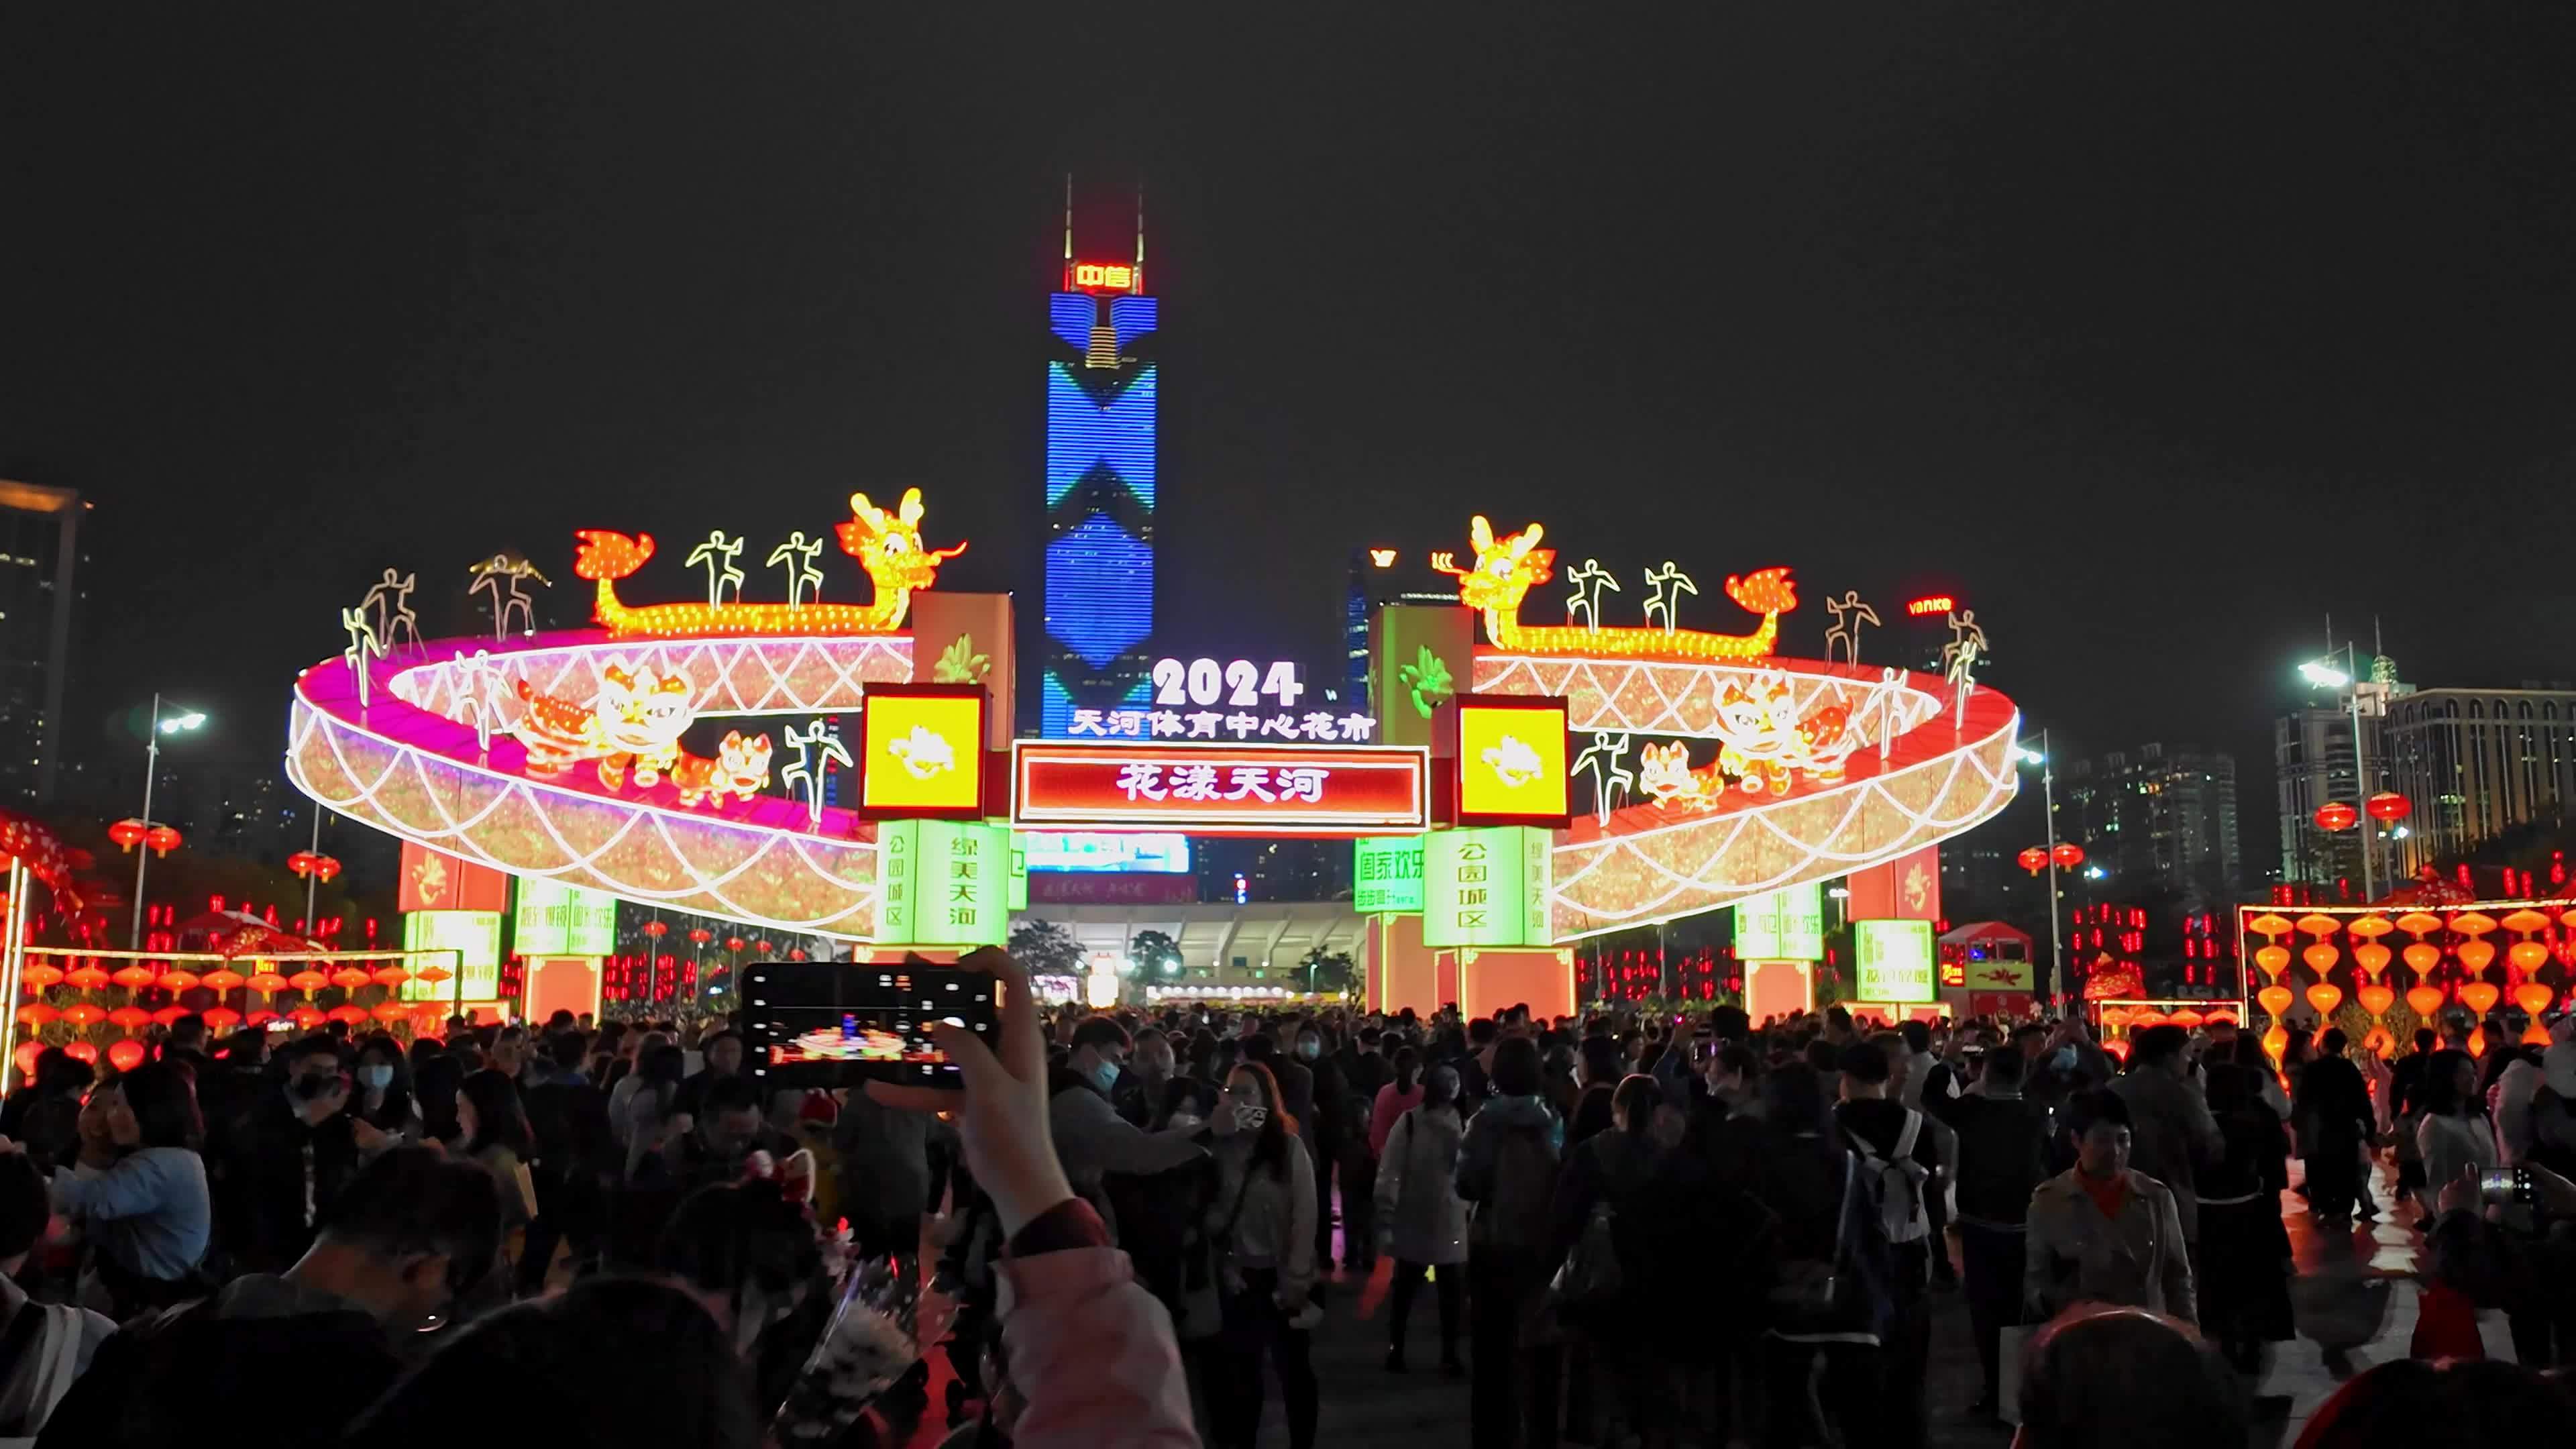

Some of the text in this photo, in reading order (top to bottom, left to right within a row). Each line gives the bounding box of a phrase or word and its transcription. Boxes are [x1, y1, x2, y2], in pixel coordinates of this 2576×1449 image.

[1077, 265, 1130, 287] 中信
[1910, 598, 1951, 615] vanke
[1152, 657, 1303, 706] 2024
[1068, 710, 1377, 741] 天河体育中心花市
[1116, 764, 1330, 803] 花漾天河
[949, 837, 977, 926] 绿美天河
[1458, 843, 1487, 928] 公园城区
